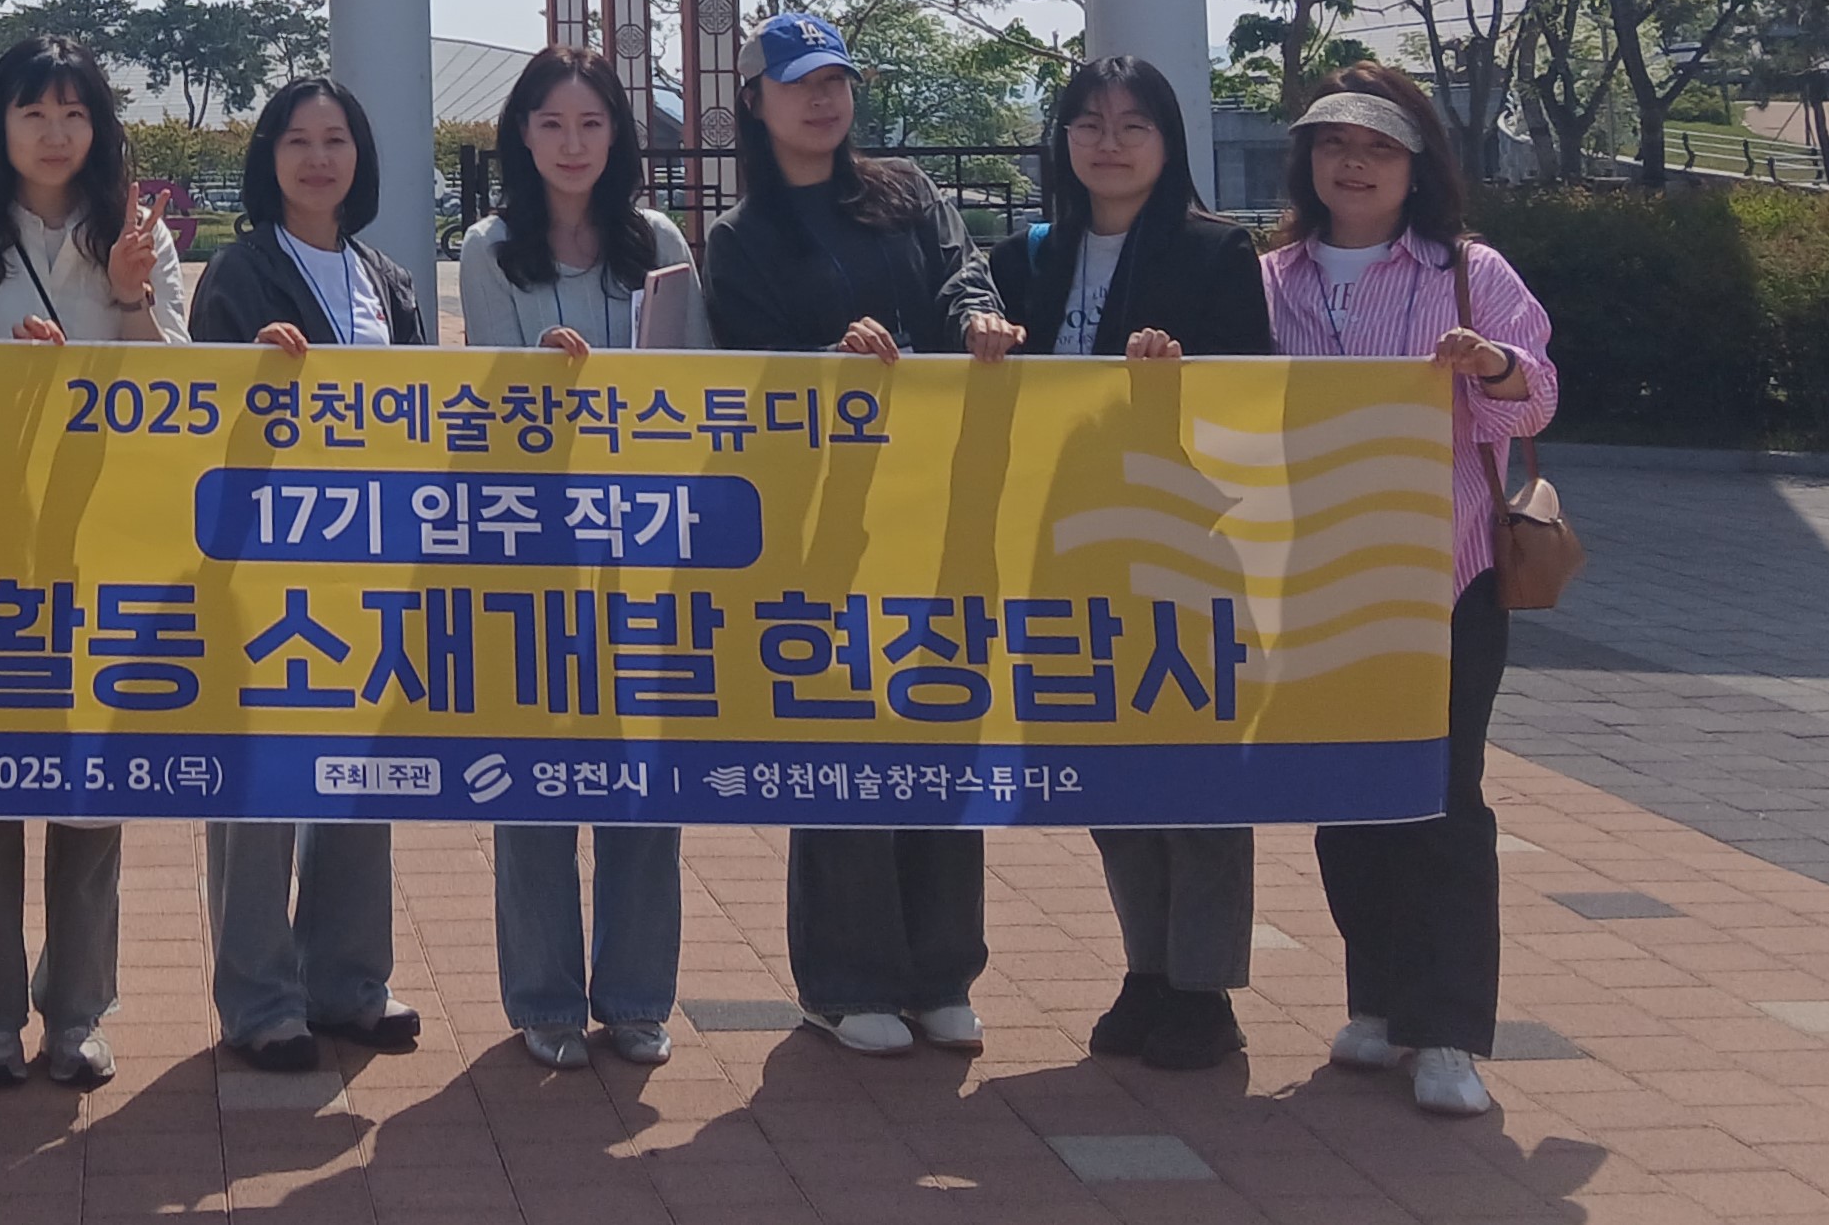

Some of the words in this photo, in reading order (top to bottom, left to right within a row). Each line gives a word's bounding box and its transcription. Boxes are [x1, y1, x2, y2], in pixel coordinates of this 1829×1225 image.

[795, 20, 826, 45] LA
[65, 379, 220, 435] 2025
[245, 381, 890, 454] 영천예술창작스튜디오
[251, 481, 383, 555] 17기
[410, 483, 540, 558] 입주
[563, 484, 701, 560] 작가
[239, 587, 725, 717] 소재개발
[755, 590, 1248, 723] 현장답사
[84, 757, 115, 790] 5.
[127, 755, 223, 796] 8.(목)
[323, 763, 368, 789] 주최
[387, 763, 432, 789] 주관
[532, 761, 648, 797] 영천시
[752, 762, 1083, 801] 영천예술창작스튜디오
